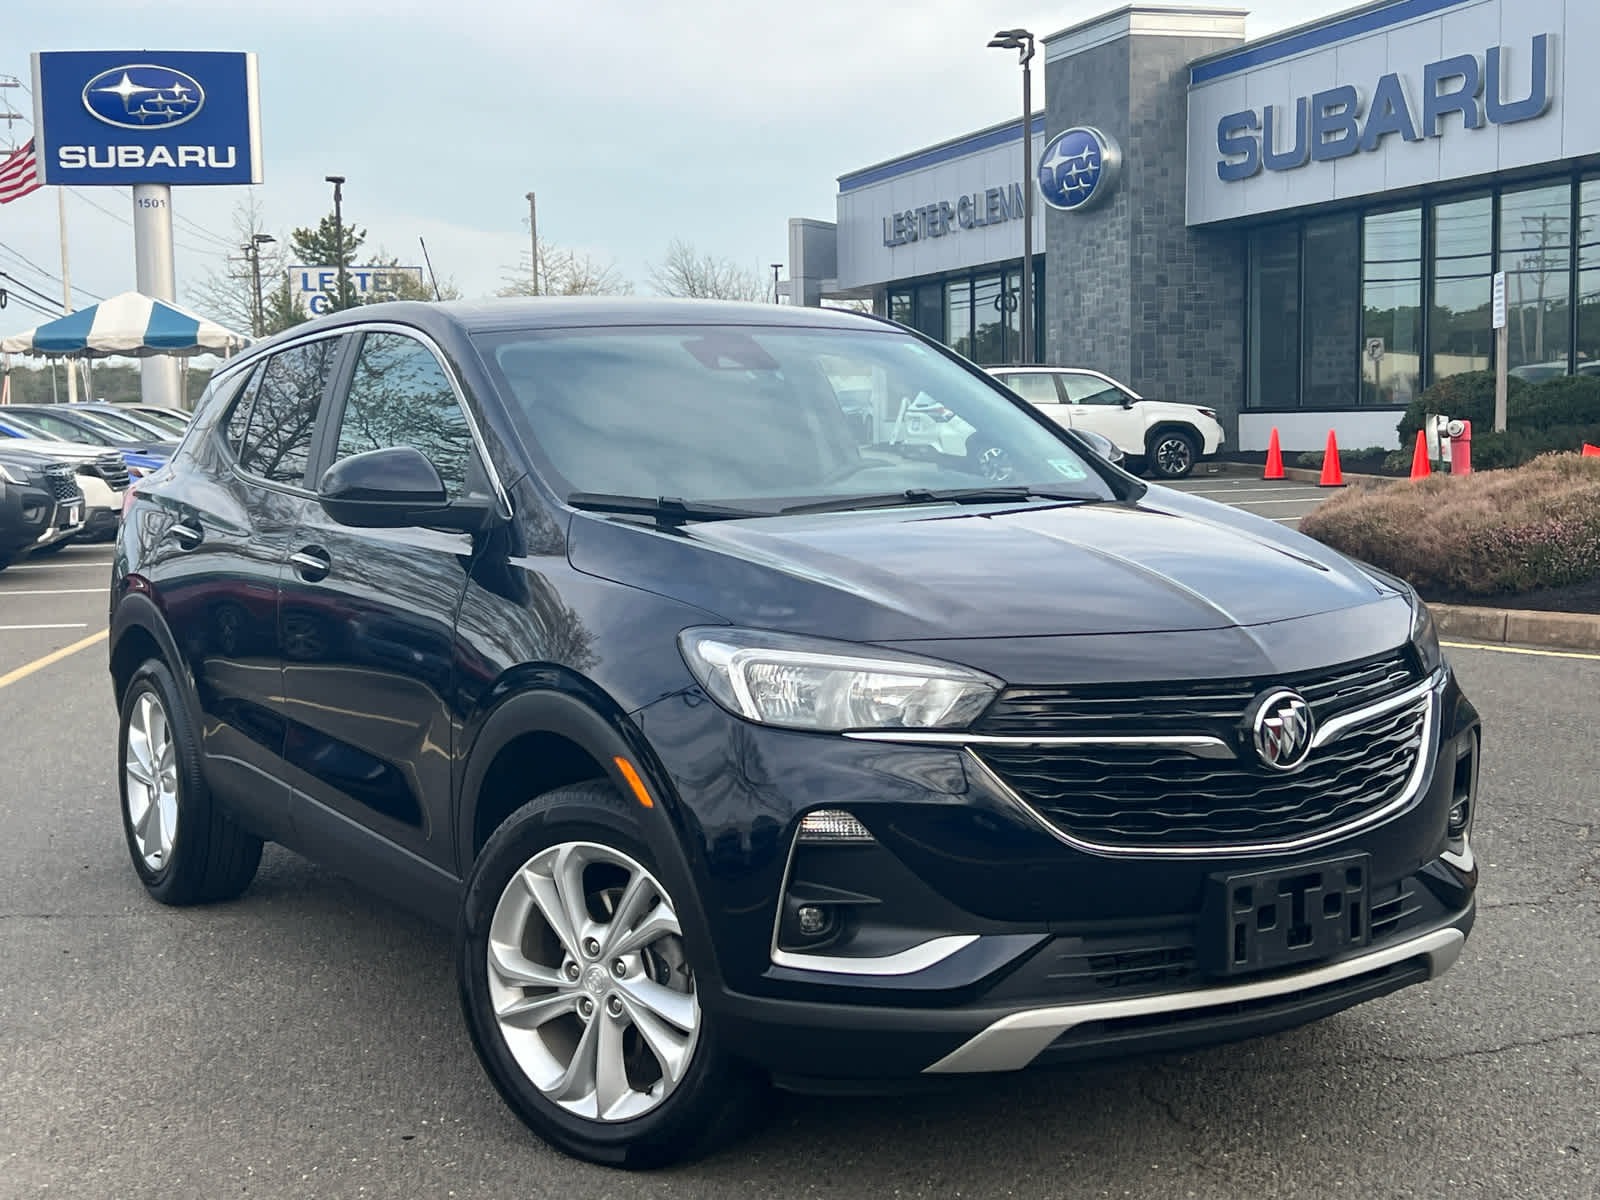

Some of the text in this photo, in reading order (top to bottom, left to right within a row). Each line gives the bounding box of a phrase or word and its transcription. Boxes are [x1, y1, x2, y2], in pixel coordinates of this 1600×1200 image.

[1217, 32, 1551, 183] SUBARU
[58, 145, 237, 169] SUBARU
[137, 198, 166, 209] 1501
[883, 200, 955, 248] LESTER
[301, 271, 407, 293] LETE
